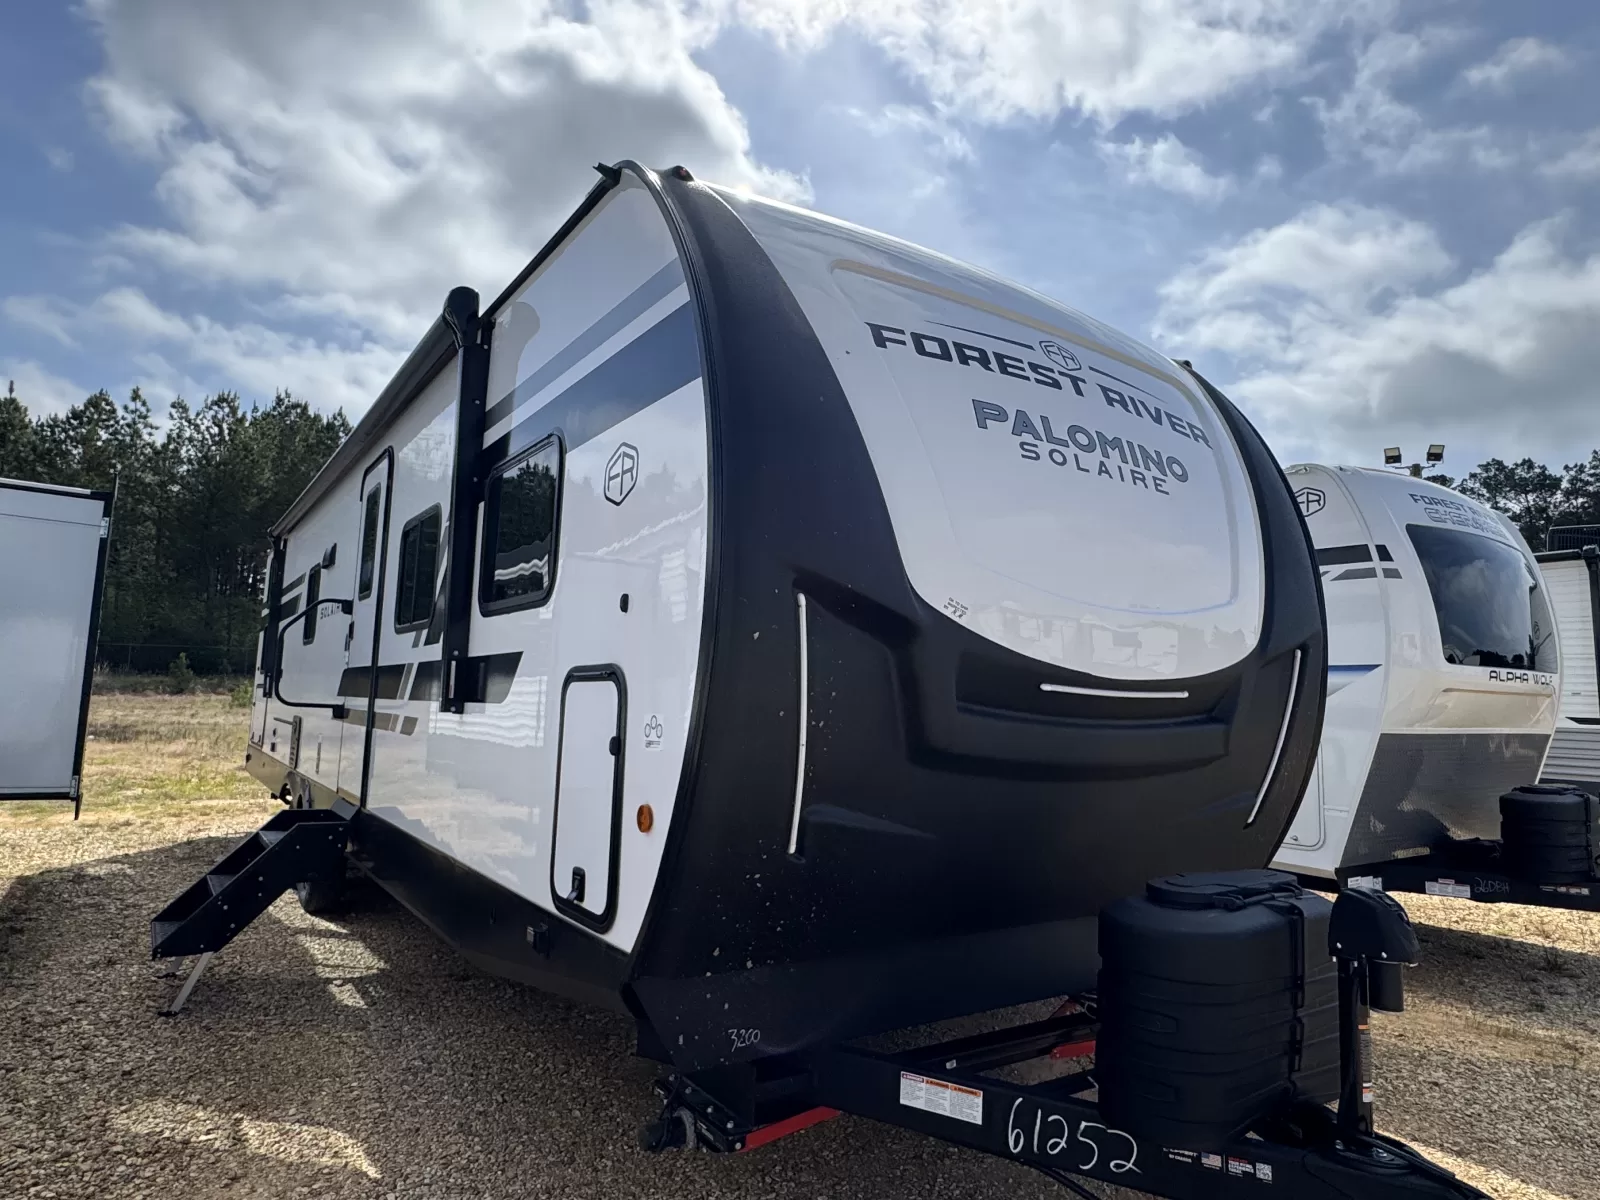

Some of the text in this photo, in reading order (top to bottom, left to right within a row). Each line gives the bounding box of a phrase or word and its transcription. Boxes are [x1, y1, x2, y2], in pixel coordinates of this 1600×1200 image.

[864, 322, 1214, 450] FOREST RIVER
[972, 399, 1189, 483] PALOMINO
[1020, 441, 1170, 496] SOLAIRE
[1408, 493, 1468, 513] FOREST
[1489, 670, 1529, 684] ALPHA
[727, 1028, 761, 1052] 3200
[1007, 1097, 1143, 1175] 61252
